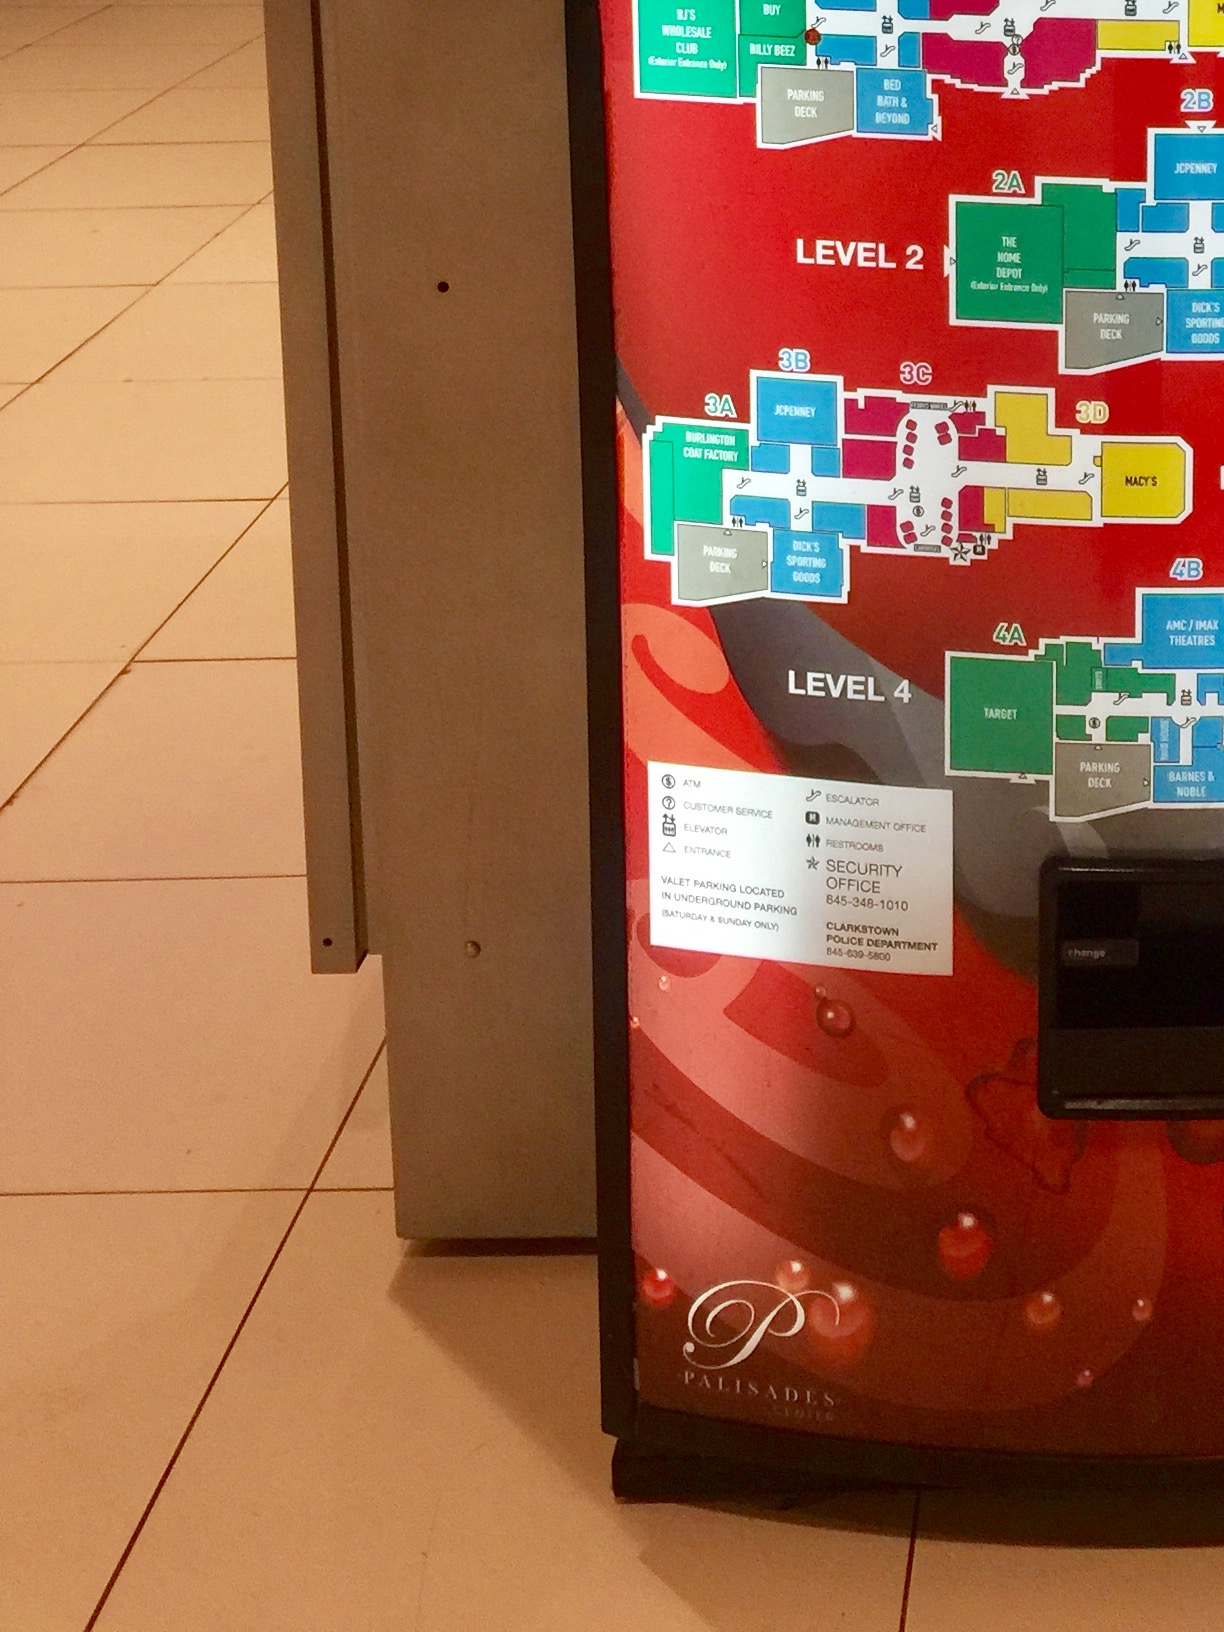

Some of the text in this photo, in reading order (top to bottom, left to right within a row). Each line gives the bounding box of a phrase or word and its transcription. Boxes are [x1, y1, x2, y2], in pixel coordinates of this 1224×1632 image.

[676, 9, 696, 21] BJ'S
[763, 4, 781, 16] BUY
[661, 25, 712, 38] WHOLESALE
[675, 42, 698, 54] CLUB
[749, 43, 796, 57] BILLY BEEZ
[677, 57, 707, 69] Entrance
[708, 59, 727, 70] Only)
[883, 79, 901, 91] BED
[787, 90, 824, 102] PARKING
[877, 95, 908, 108] BATH &
[1181, 90, 1213, 112] 2B
[794, 106, 818, 118] DECK
[875, 112, 910, 124] BEYOND
[1174, 162, 1217, 174] JCPENNEY
[993, 171, 1024, 192] 2A
[1002, 236, 1017, 247] THE
[797, 240, 924, 269] LEVEL 2
[997, 251, 1022, 264] HOME
[996, 267, 1022, 279] DEPOT
[1000, 283, 1029, 292] Entrance
[1192, 302, 1220, 313] DICK'S
[1093, 313, 1130, 325] PARKING
[1100, 328, 1122, 340] DECK
[1191, 333, 1219, 344] GOODS
[779, 349, 809, 371] 3B
[901, 363, 931, 384] 3C
[706, 394, 735, 417] 3A
[774, 405, 816, 418] JCPENNEY
[1076, 402, 1108, 423] 3D
[685, 432, 736, 446] BURLINGTON
[683, 447, 739, 462] COAT FACTORY
[1125, 475, 1157, 487] MACY'S
[703, 545, 738, 559] PARKING
[792, 540, 820, 552] DICK'S
[710, 561, 732, 574] DECK
[786, 556, 827, 568] SPORTING
[1171, 558, 1202, 580] 4B
[793, 572, 821, 584] GOODS
[1166, 619, 1219, 631] AMC IMAX
[994, 623, 1025, 646] 4A
[1169, 635, 1216, 646] THEATRES
[788, 670, 912, 704] LEVEL 4
[984, 708, 1018, 720] TARGET
[1080, 762, 1120, 774] PARKING
[683, 778, 701, 788] ATM
[1088, 777, 1112, 789] DECK
[1168, 771, 1214, 783] BARNES &
[1176, 786, 1206, 797] NOBLE
[826, 793, 880, 806] ESCALATOR
[684, 801, 773, 819] CUSTOMER SERVICE
[684, 823, 728, 836] ELEVATOR
[826, 816, 926, 833] MANAGEMENT OFFICE
[826, 838, 884, 852] RESTROOMS
[684, 846, 731, 858] ENTRANCE
[826, 860, 903, 877] SECURITY
[661, 876, 785, 898] VALET PARKING LOCATED
[826, 877, 881, 894] OFFICE
[661, 891, 798, 915] IN UNDERGROUND PARKING
[826, 895, 909, 912] 845-348-1010
[661, 908, 708, 922] (SATURDAY
[717, 915, 752, 927] SUNDAY
[754, 919, 780, 932] ONLY)
[826, 922, 899, 936] CLARKSTOWN
[826, 935, 938, 952] POLICE DEPARTMENT
[1067, 948, 1106, 959] change
[684, 1370, 835, 1406] PALISADES
